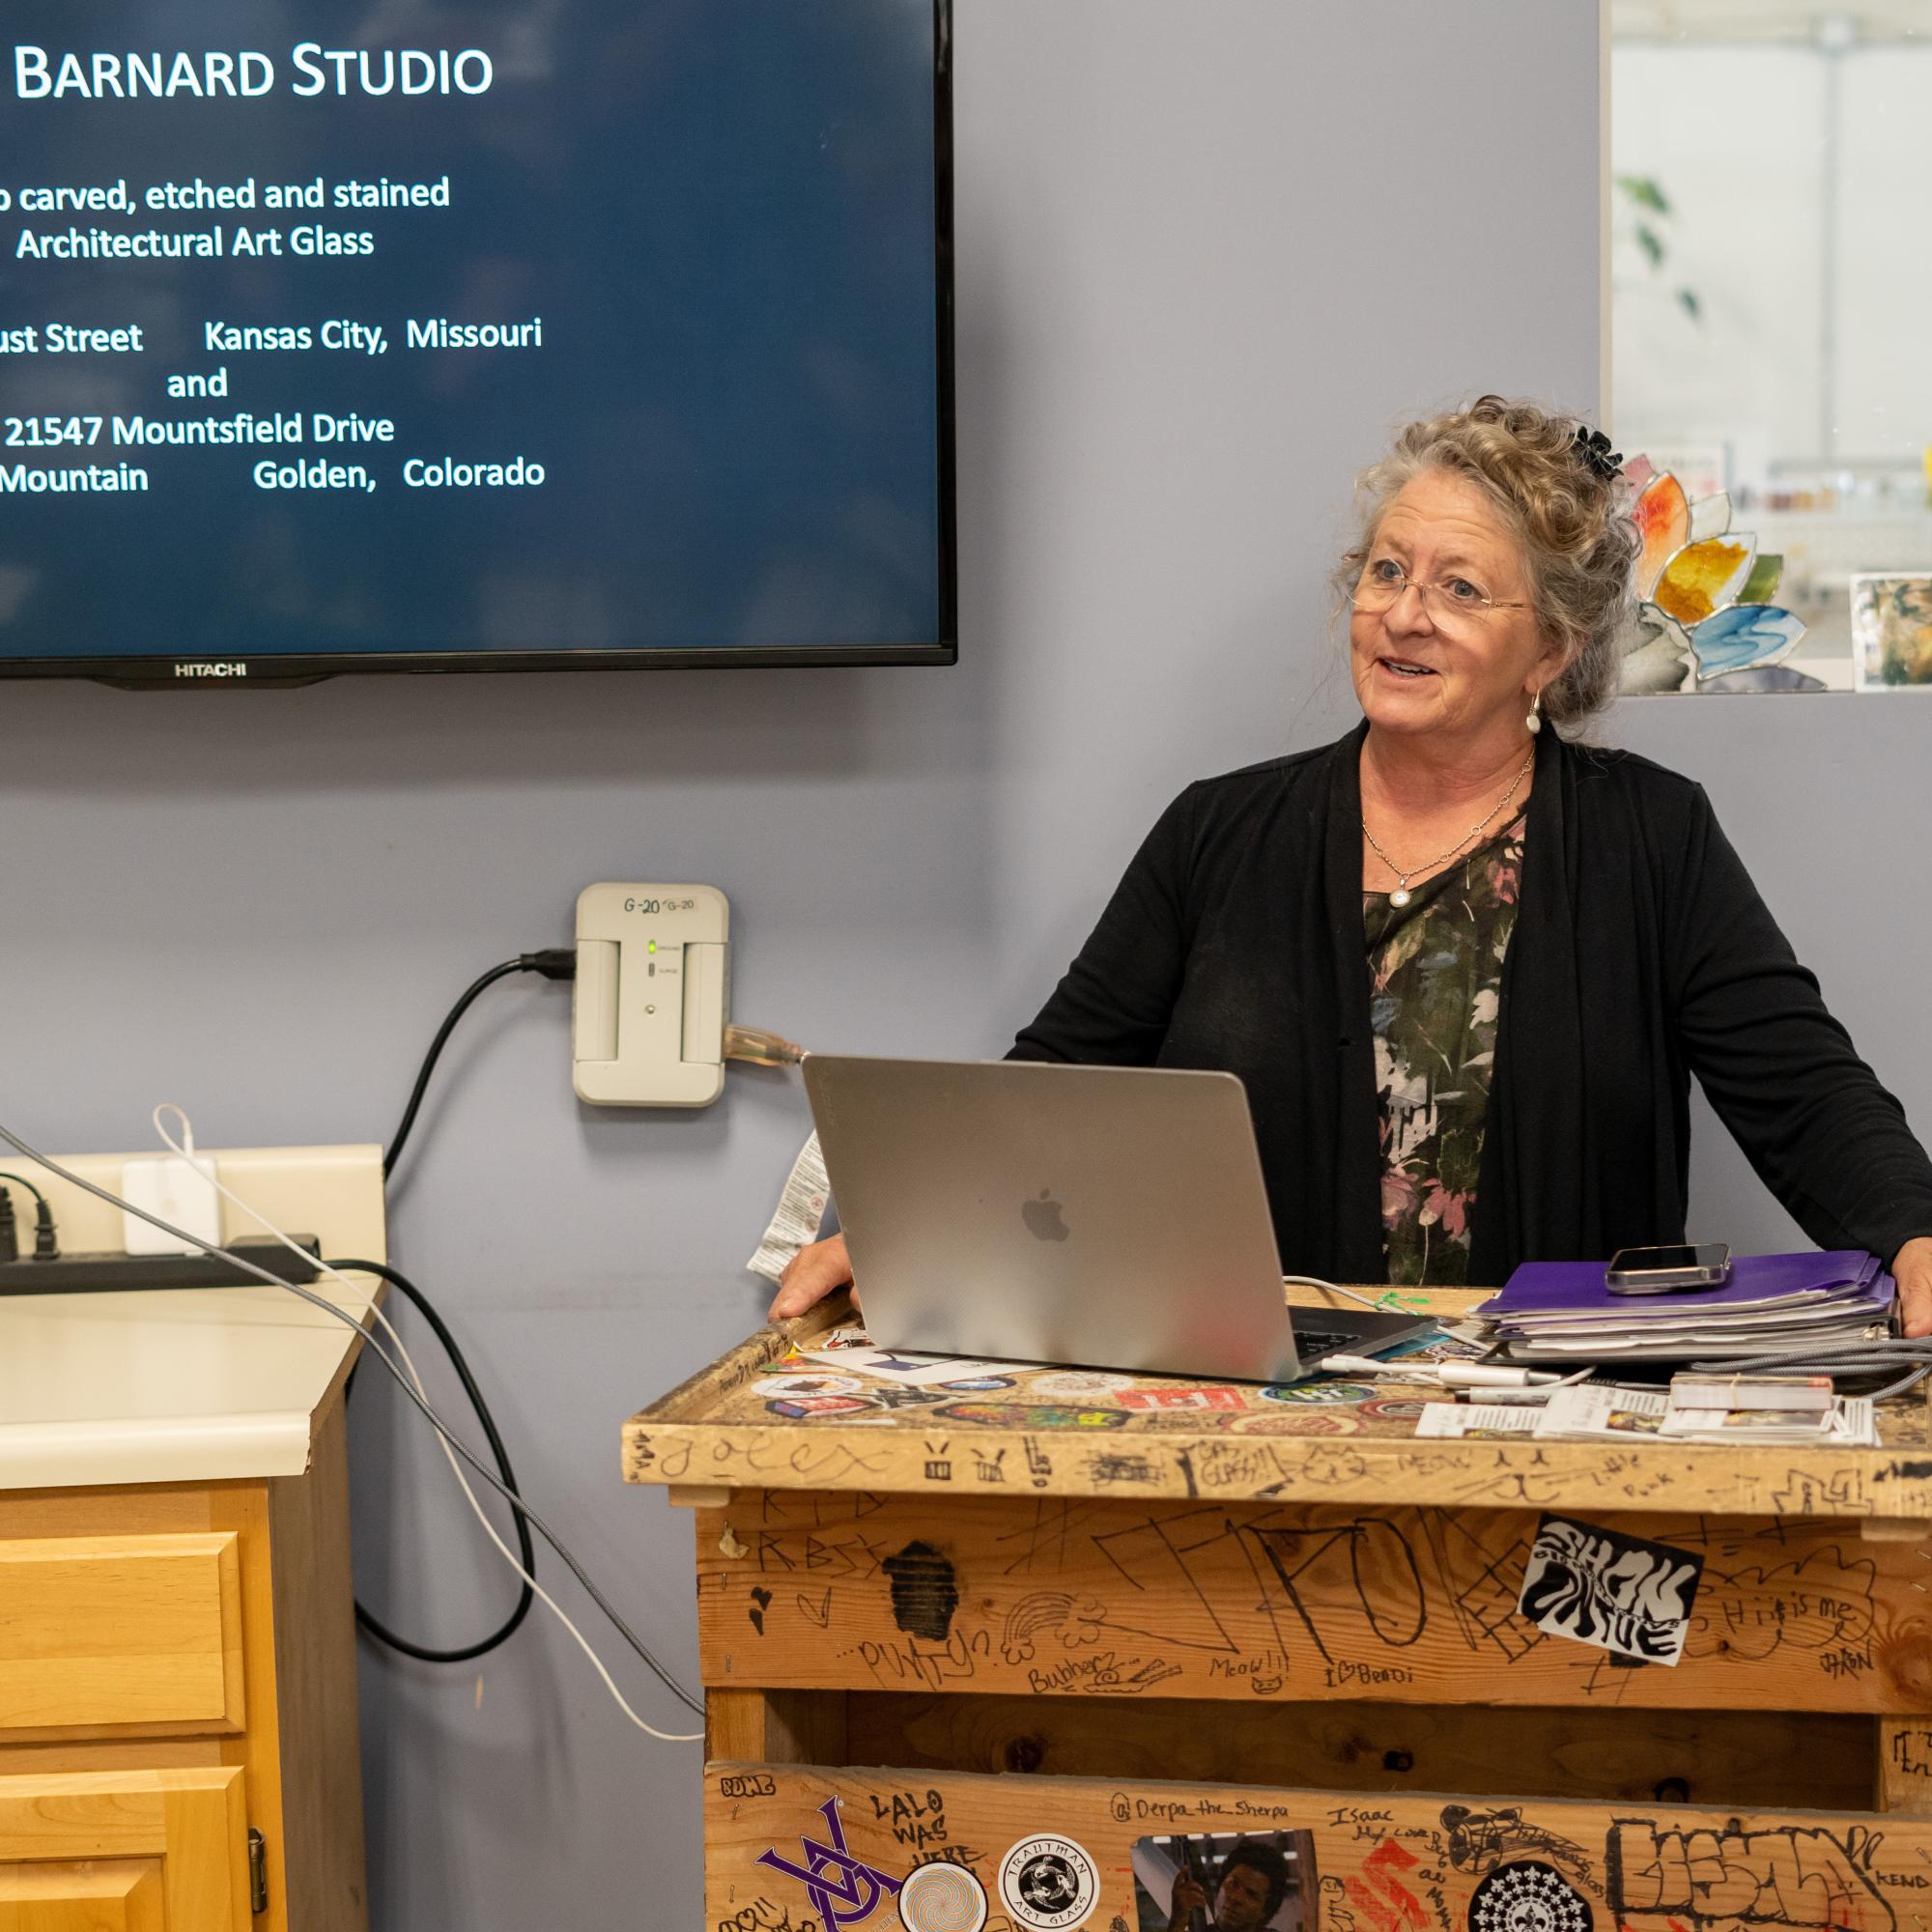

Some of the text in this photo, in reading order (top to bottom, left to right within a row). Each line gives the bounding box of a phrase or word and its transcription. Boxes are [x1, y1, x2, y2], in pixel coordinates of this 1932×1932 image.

[14, 42, 494, 99] BARNARD STUDIO
[18, 179, 137, 215] carved,
[145, 177, 256, 211] etched
[264, 177, 325, 209] and
[333, 175, 450, 208] stained
[15, 224, 375, 259] Architectural Art Glass
[44, 323, 144, 353] Street
[205, 317, 542, 355] Kansas City, Missouri
[167, 366, 228, 398] and
[4, 412, 395, 447] 21547 Mountsfield Drive
[0, 462, 149, 493] Mountain
[253, 456, 546, 494] Golden, Colorado
[174, 663, 247, 677] HITACHI
[869, 1789, 944, 1826] LALO
[1327, 1807, 1394, 1827] Isaac
[893, 1814, 948, 1851] WAS
[1008, 1842, 1088, 1877] TRAUTMAN
[1013, 1895, 1088, 1925] ART GLASS
